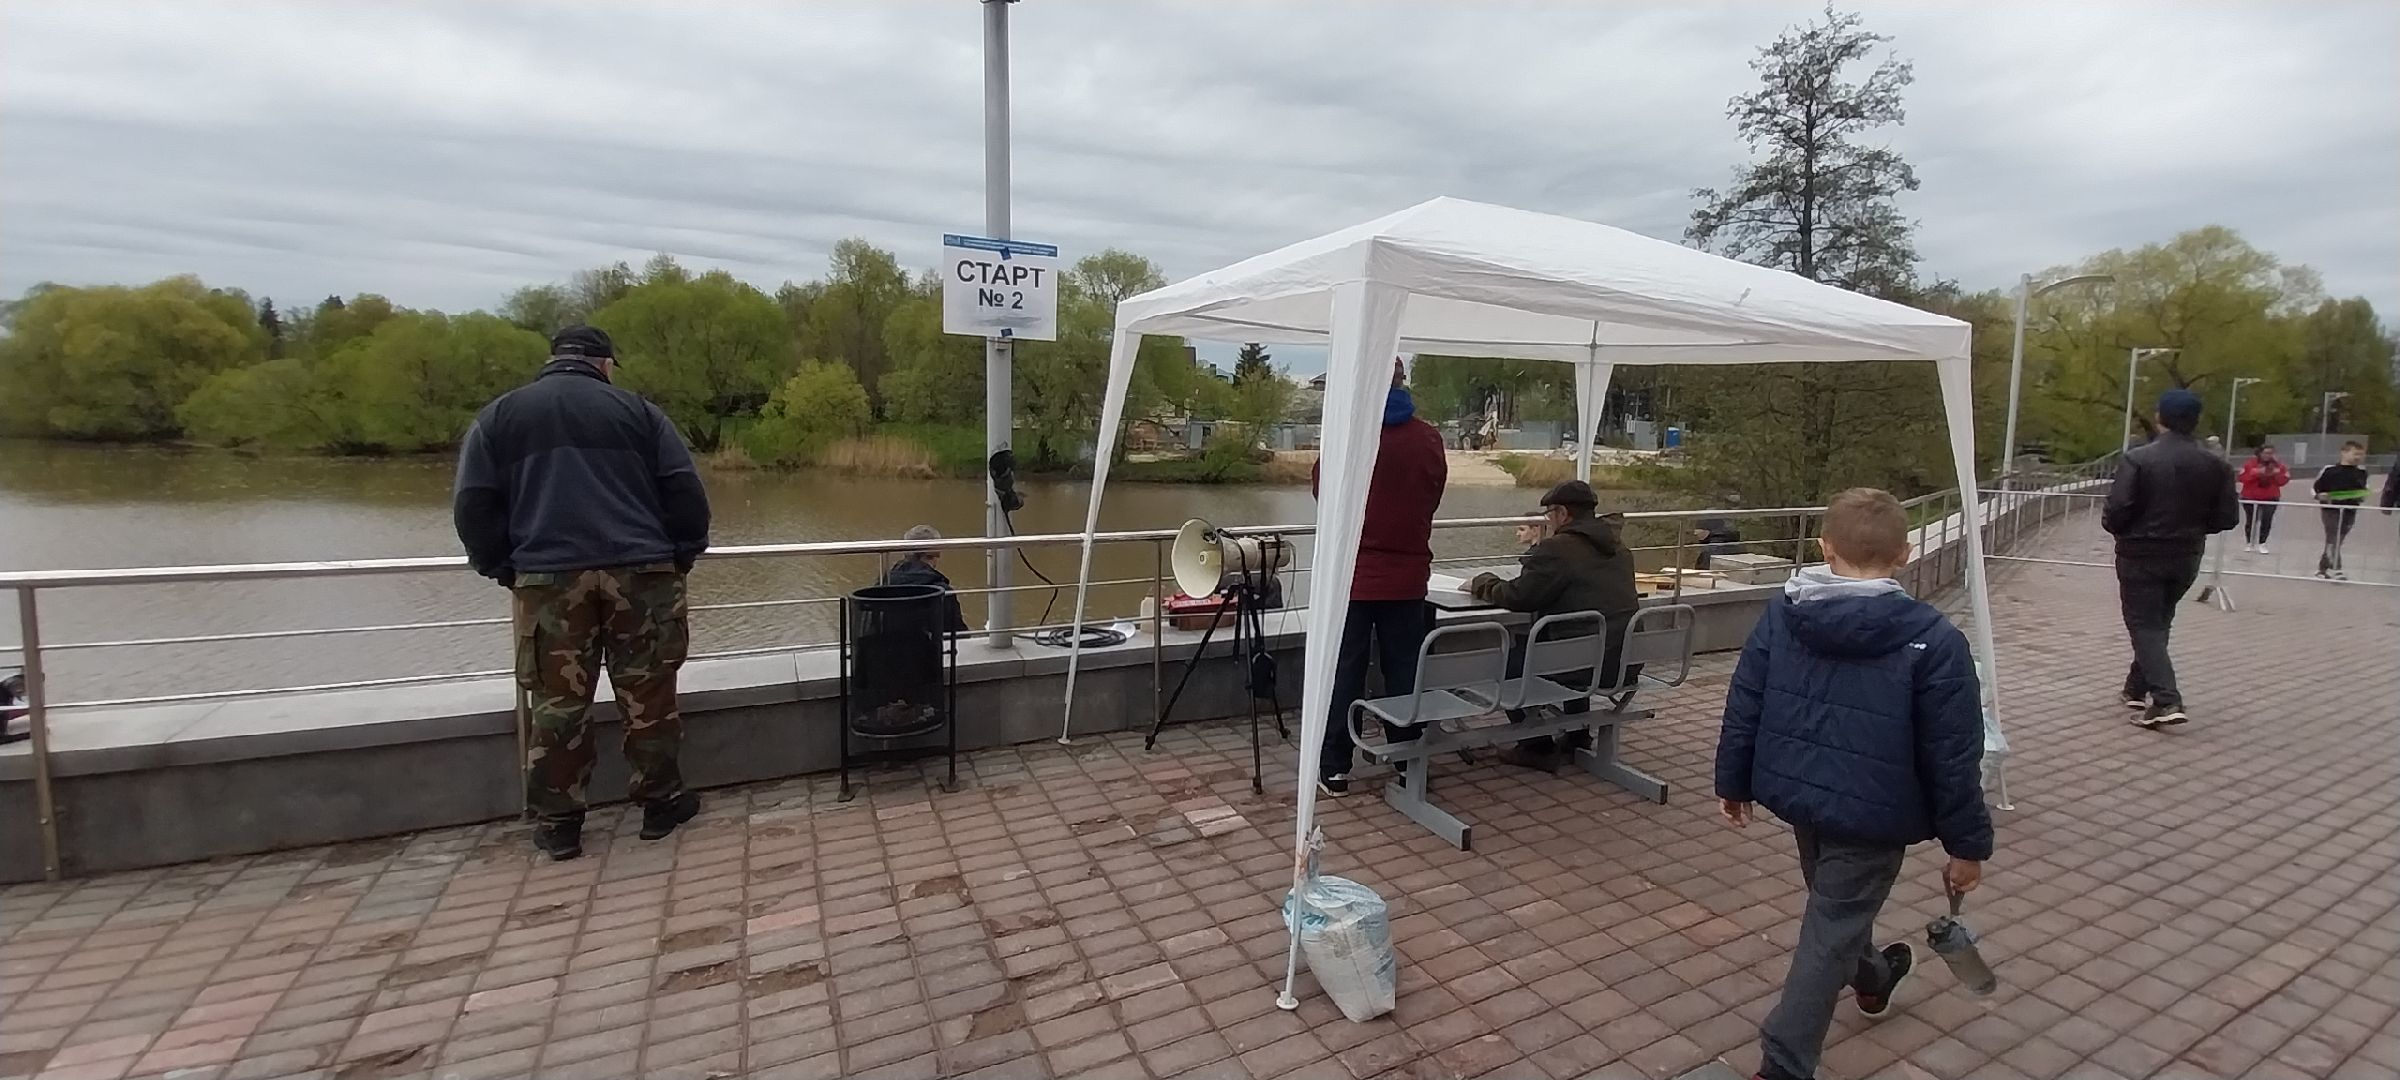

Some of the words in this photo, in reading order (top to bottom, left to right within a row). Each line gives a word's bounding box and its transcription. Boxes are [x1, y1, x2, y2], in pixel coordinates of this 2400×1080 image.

[957, 260, 1045, 288] СТАРТ
[979, 288, 1004, 307] №
[1011, 291, 1023, 309] 2
